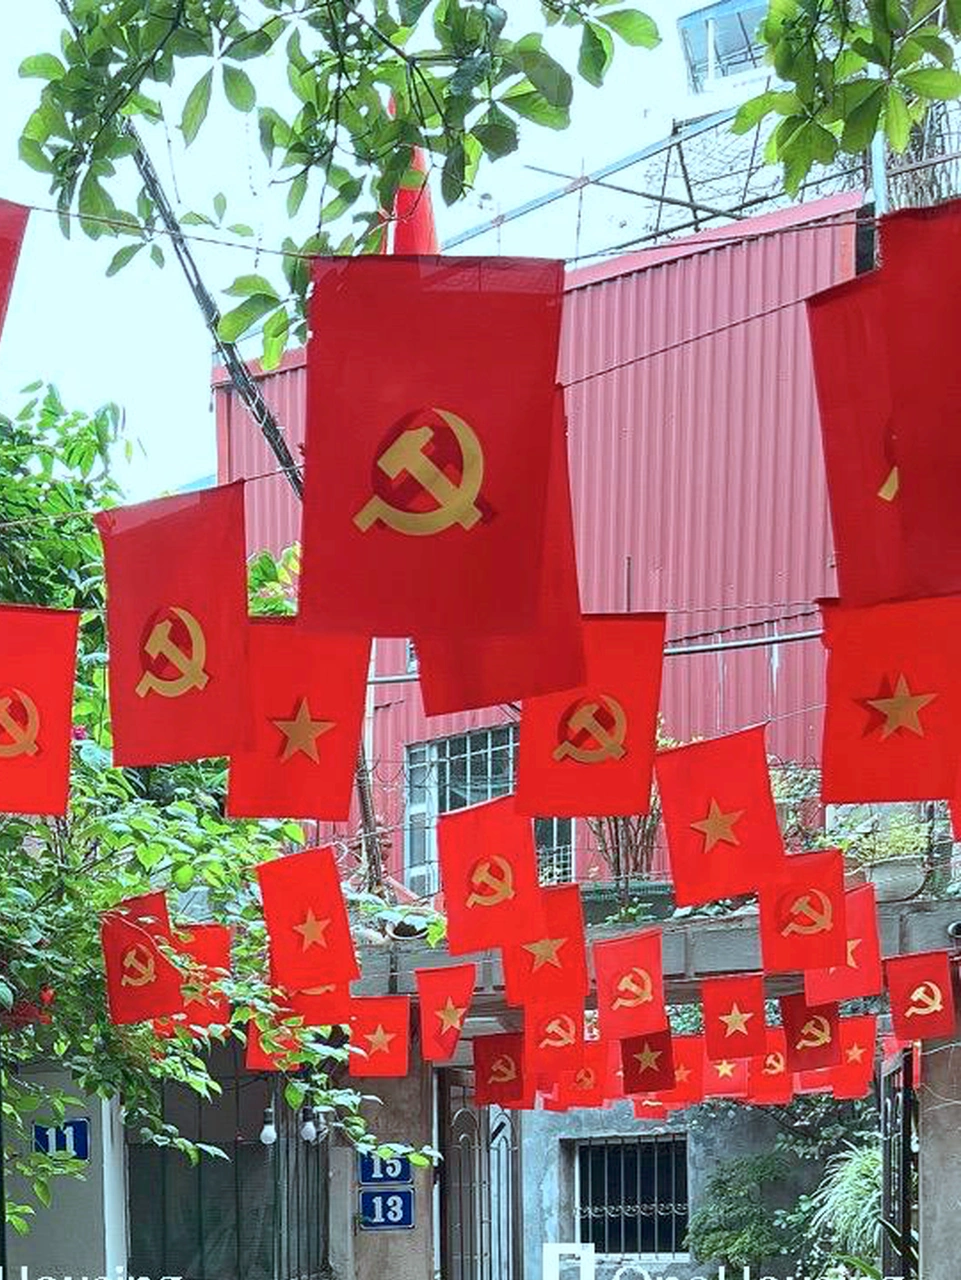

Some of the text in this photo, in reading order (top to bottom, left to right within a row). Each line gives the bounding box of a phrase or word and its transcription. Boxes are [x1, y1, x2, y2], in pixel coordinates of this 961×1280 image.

[45, 1126, 77, 1157] 11
[371, 1154, 402, 1178] 15
[372, 1195, 404, 1223] 13
